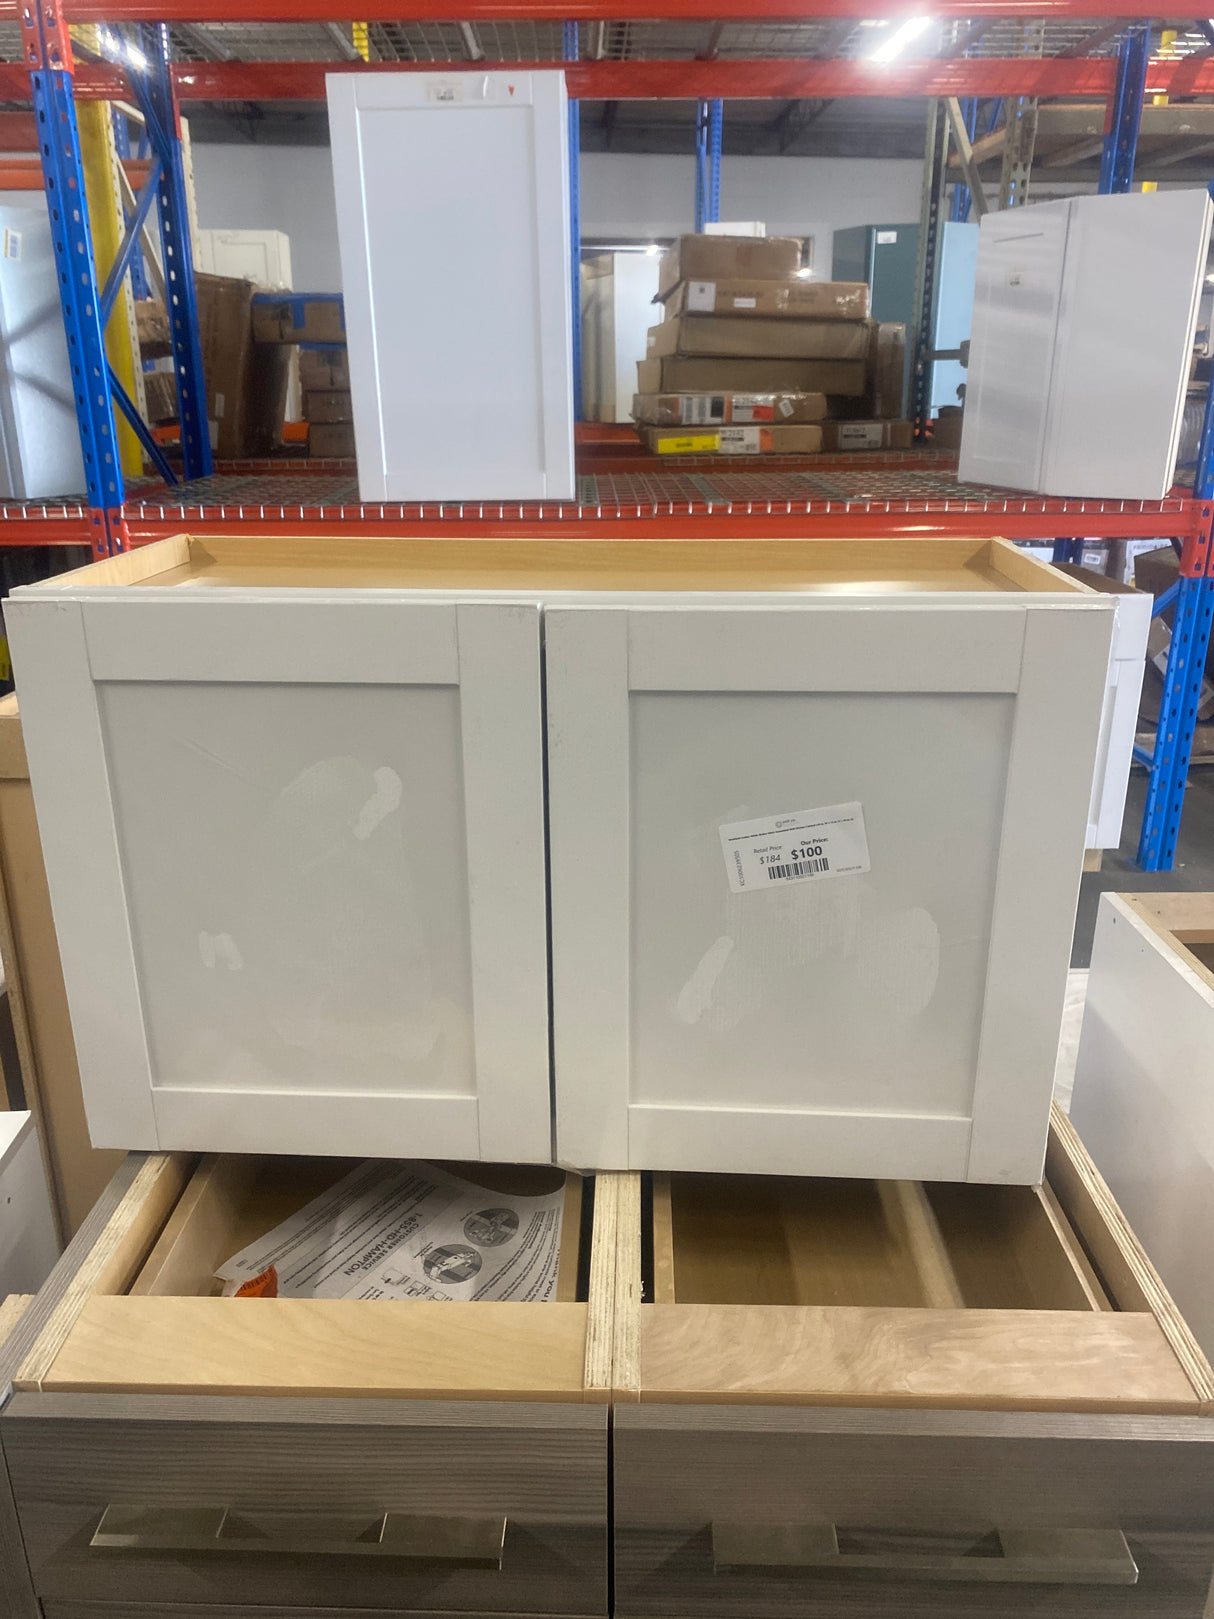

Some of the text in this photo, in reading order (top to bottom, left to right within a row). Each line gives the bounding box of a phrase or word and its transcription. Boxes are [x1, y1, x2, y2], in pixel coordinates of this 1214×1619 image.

[760, 854, 781, 864] $184
[791, 846, 823, 860] $100
[387, 1223, 419, 1250] CUSTOMER
[362, 1249, 388, 1270] SERVICE
[544, 1280, 554, 1298] you
